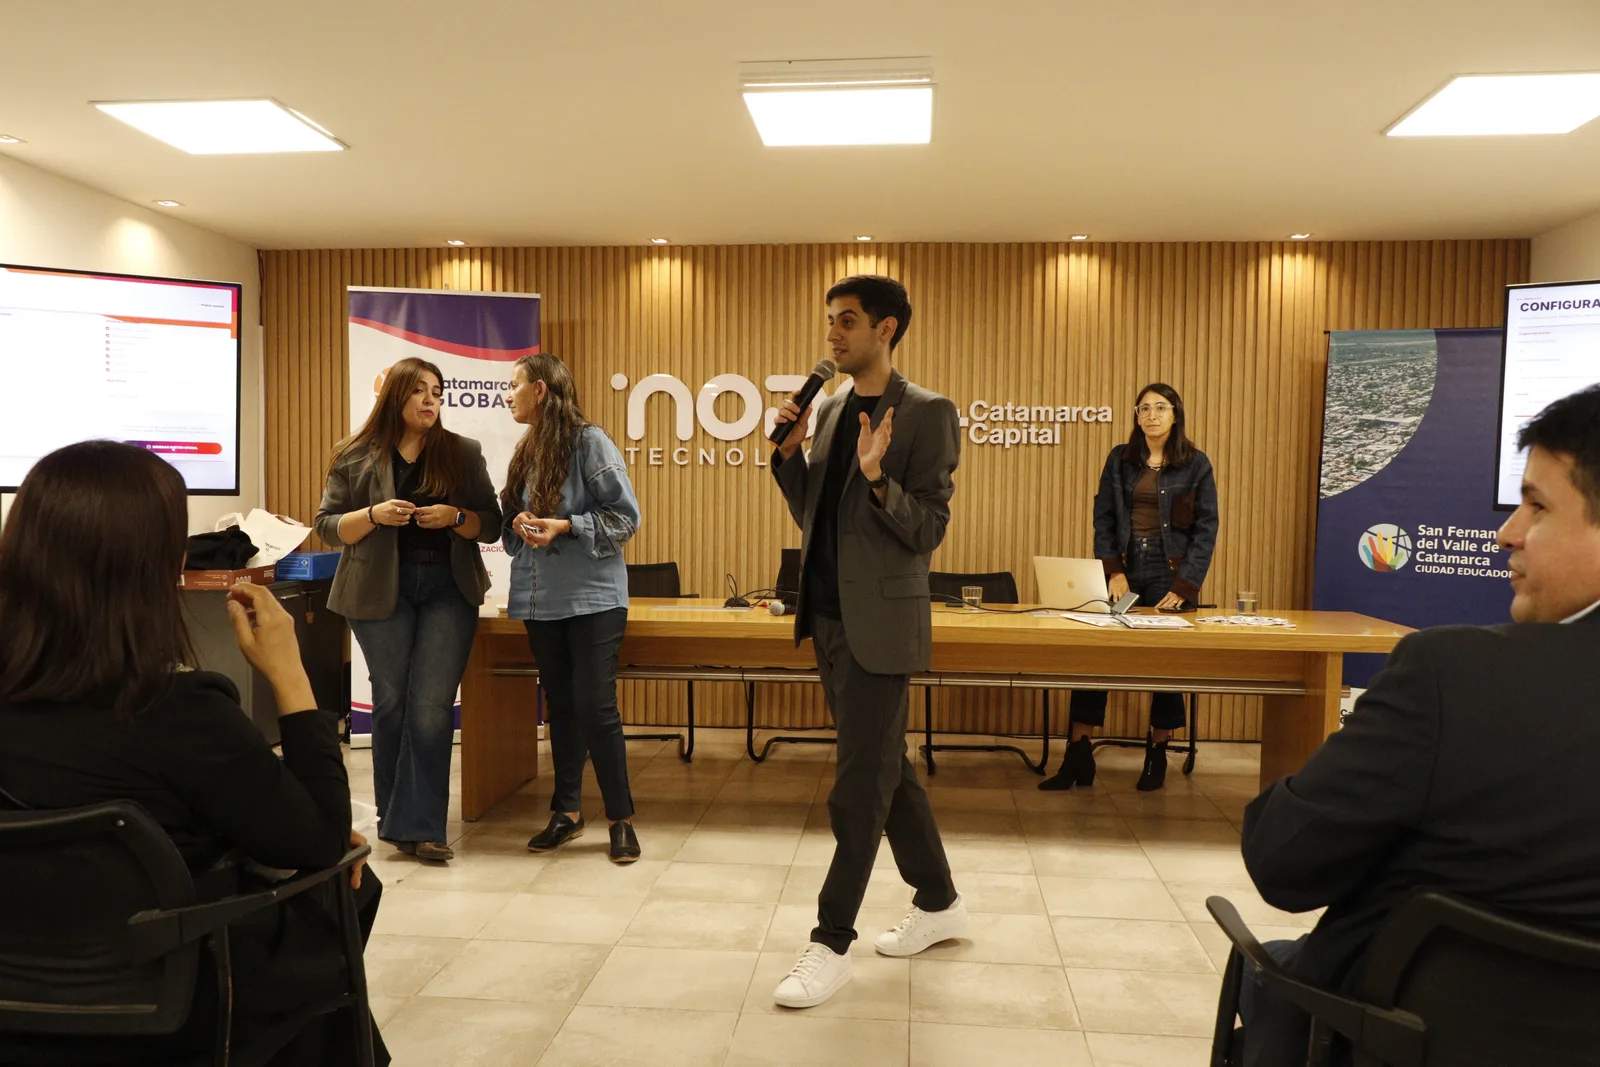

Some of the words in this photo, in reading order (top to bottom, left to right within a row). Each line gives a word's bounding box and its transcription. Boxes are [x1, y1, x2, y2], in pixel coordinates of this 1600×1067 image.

[1520, 299, 1600, 312] CONFIGURA
[969, 400, 1112, 422] Catamarca
[969, 422, 1061, 448] Capital
[1417, 524, 1443, 536] San
[1447, 526, 1497, 539] Fernan
[1416, 538, 1438, 549] del
[1442, 539, 1478, 552] Valle
[1481, 541, 1500, 553] de
[1415, 551, 1491, 566] Catamarca
[1415, 564, 1455, 575] CIUDAD
